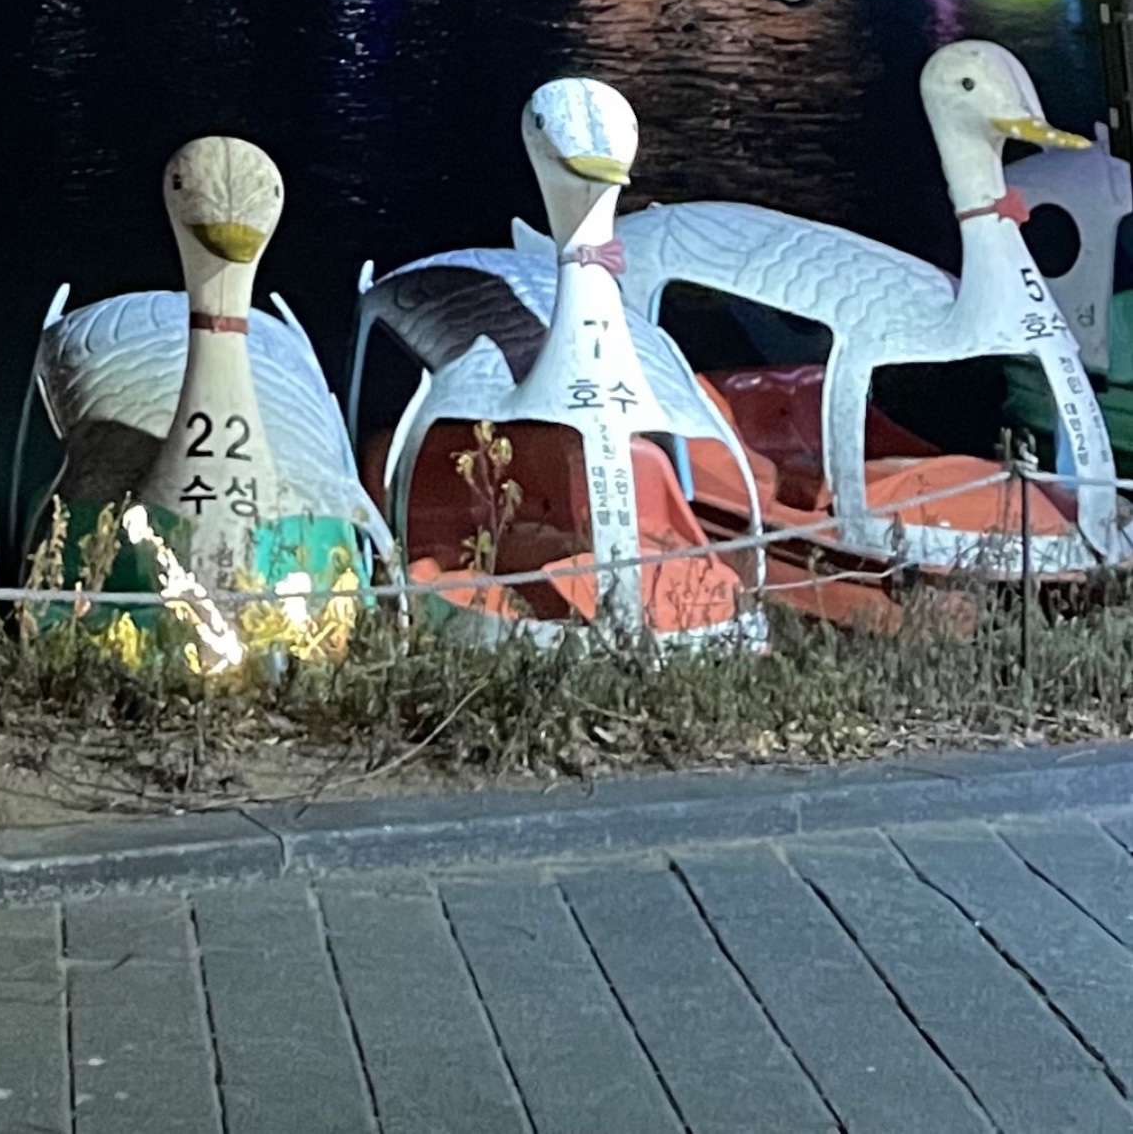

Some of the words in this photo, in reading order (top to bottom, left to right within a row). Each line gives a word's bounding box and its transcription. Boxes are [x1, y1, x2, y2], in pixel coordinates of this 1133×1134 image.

[1020, 268, 1045, 302] 5
[1020, 312, 1067, 340] 호수
[567, 379, 639, 414] 호수
[186, 411, 252, 462] 22
[179, 474, 261, 517] 수성
